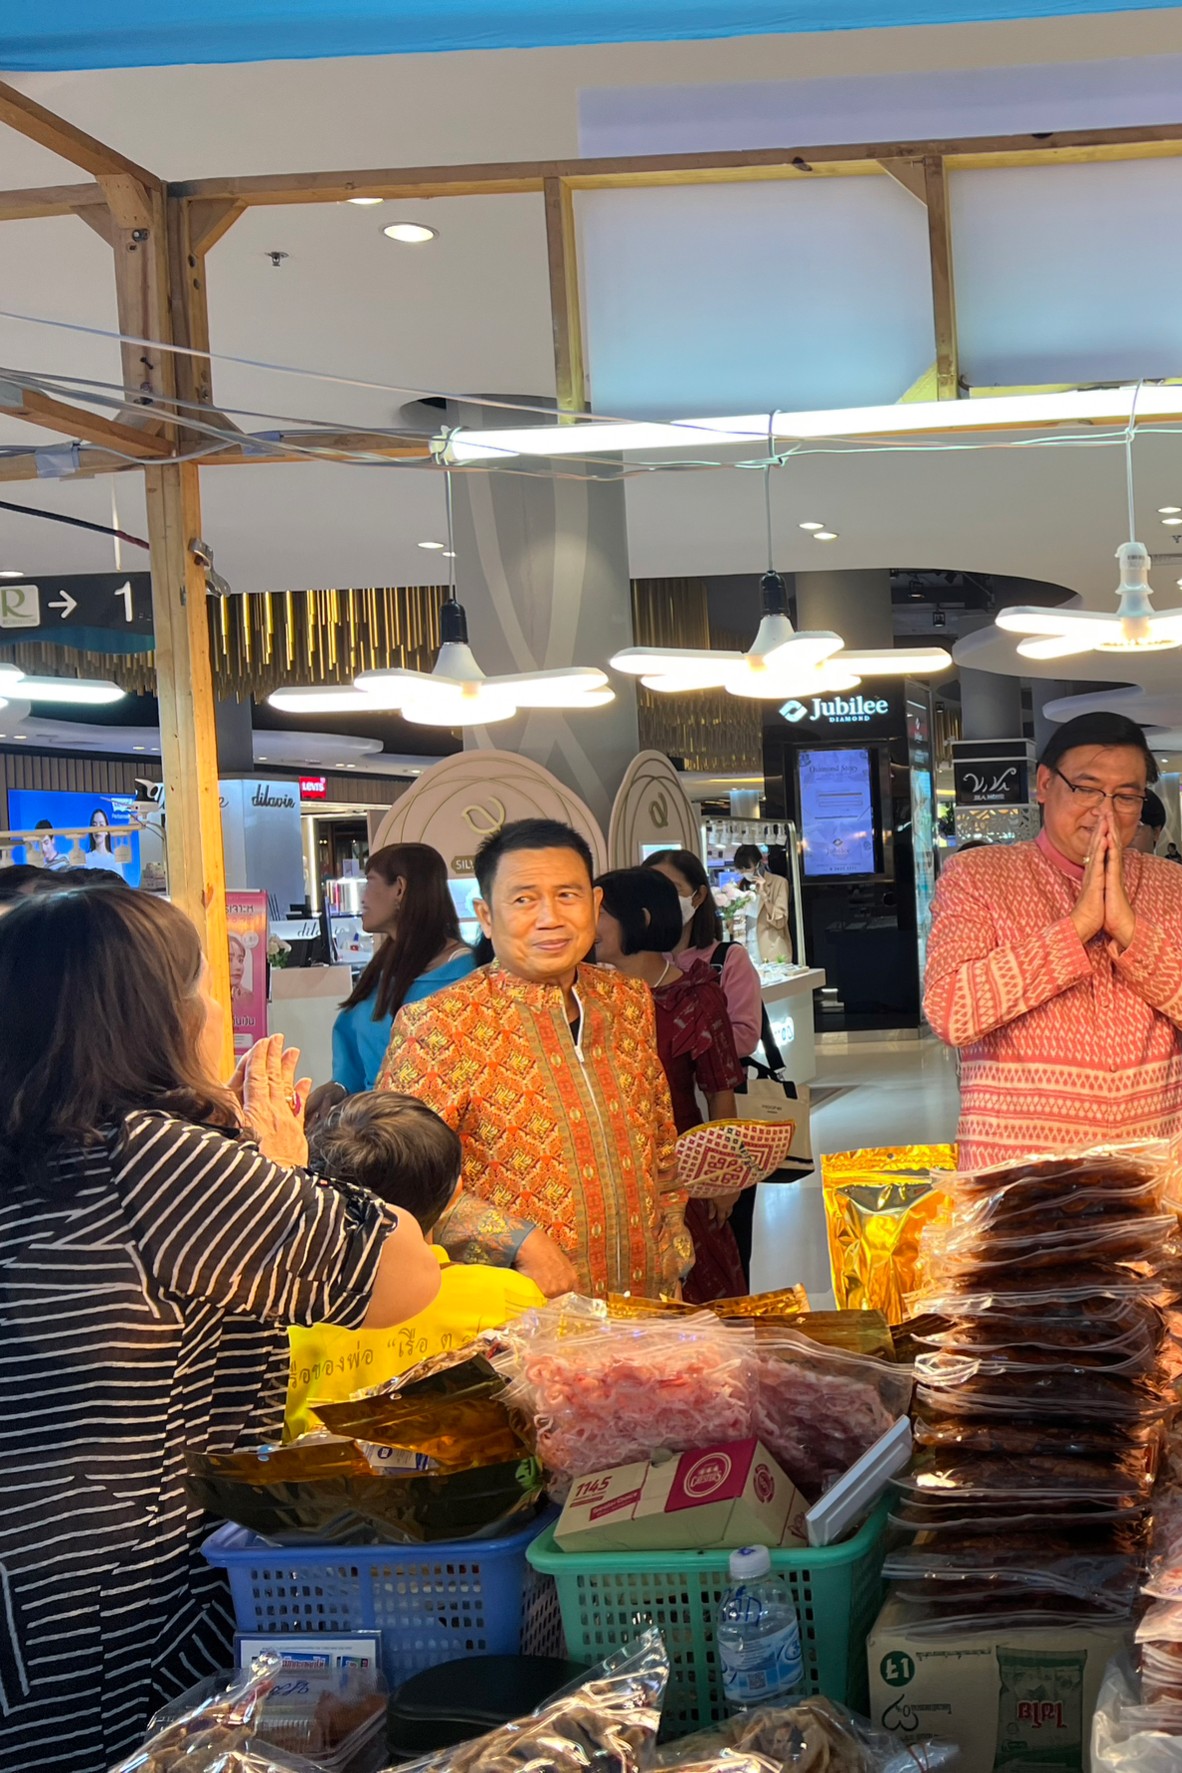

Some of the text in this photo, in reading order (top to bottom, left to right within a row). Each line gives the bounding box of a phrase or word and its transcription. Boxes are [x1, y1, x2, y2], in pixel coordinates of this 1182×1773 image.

[1, 588, 34, 618] R
[114, 580, 133, 623] 1
[809, 695, 889, 721] Jubilee
[829, 715, 870, 723] DIAMOND
[576, 1475, 613, 1498] 1145
